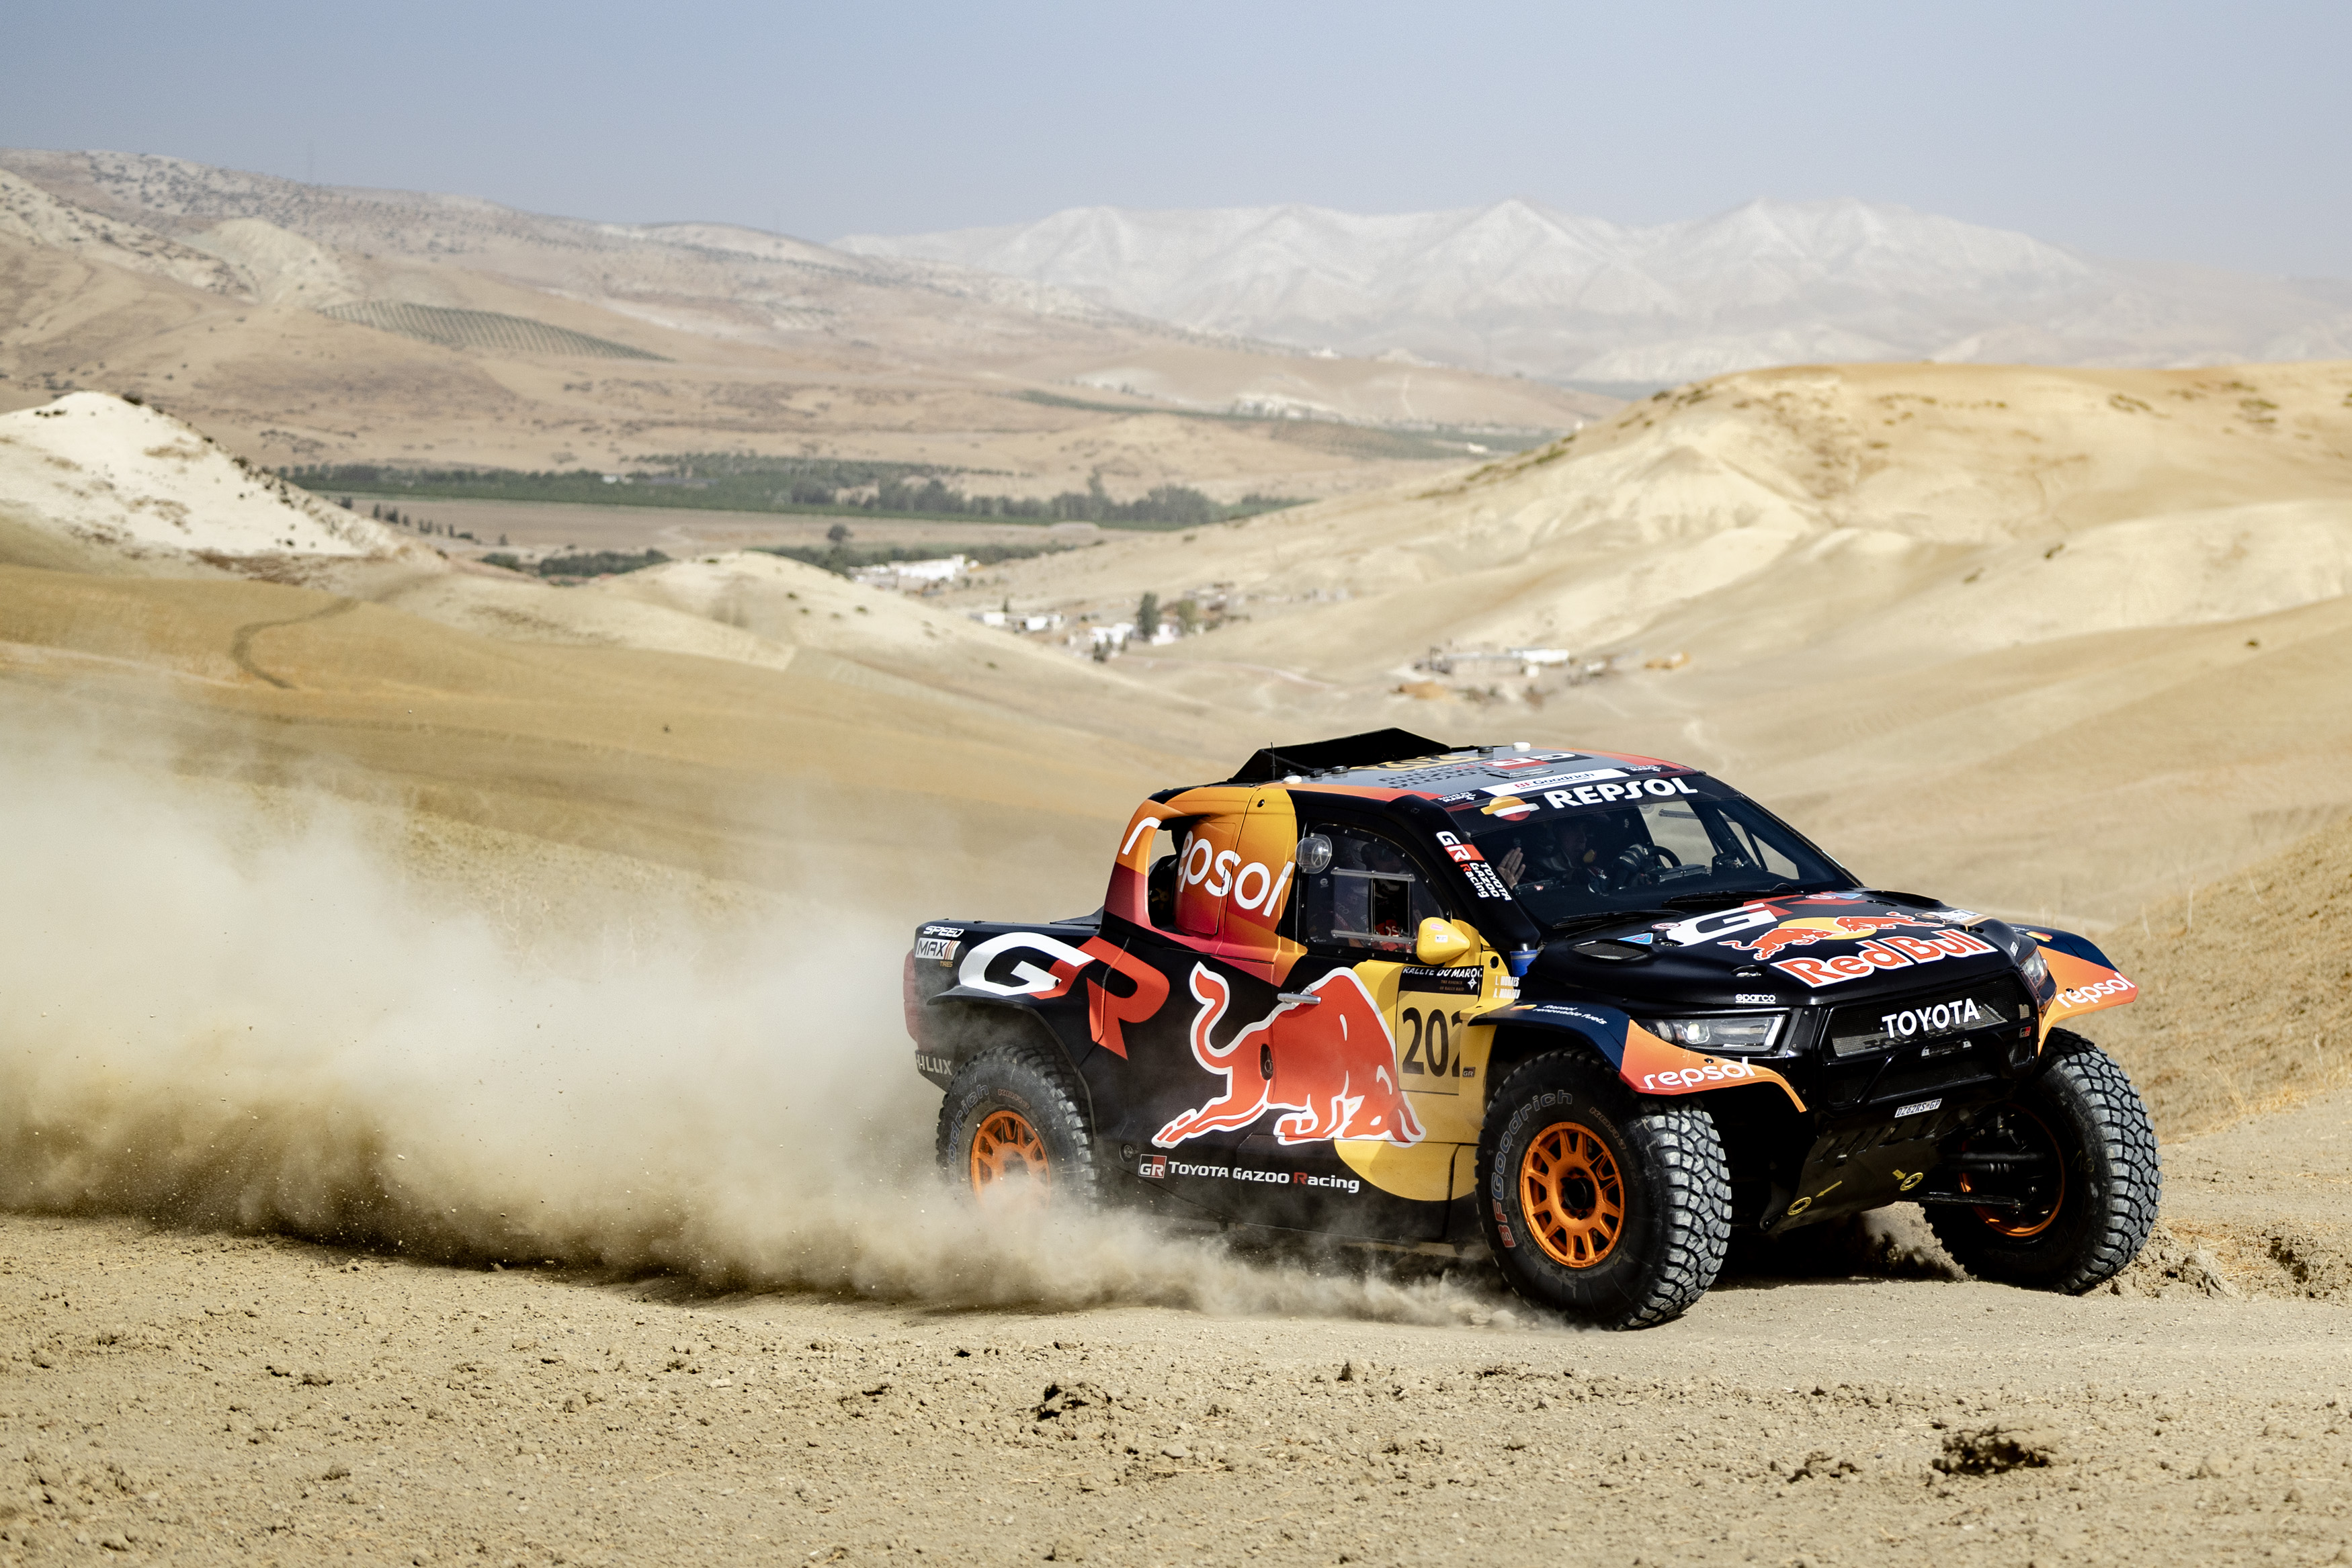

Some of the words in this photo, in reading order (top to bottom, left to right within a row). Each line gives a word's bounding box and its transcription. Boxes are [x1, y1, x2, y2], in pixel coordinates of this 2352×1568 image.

[1513, 771, 1597, 789] BFGoodrich
[1543, 777, 1699, 810] REPSOL
[1435, 830, 1472, 861] GR
[1121, 816, 1296, 918] repsol
[1460, 863, 1490, 898] Racing
[1469, 862, 1501, 898] GAZOO
[1480, 862, 1513, 901] TOYOTA
[917, 940, 948, 957] MAX
[923, 925, 965, 938] SPEED
[1436, 968, 1452, 977] DU
[1450, 967, 1483, 978] MAROC
[1770, 939, 1916, 988] Red
[1876, 928, 1999, 964] Bull
[958, 931, 1171, 1061] GR
[1735, 993, 1776, 1004] sparco
[2056, 971, 2136, 1008] repsol
[1581, 1013, 1607, 1025] fuels
[1881, 998, 1982, 1039] TOYOTA
[1643, 1056, 1756, 1090] repsol
[948, 1084, 990, 1184] oodrich
[1139, 1163, 1165, 1176] GR
[1168, 1161, 1229, 1178] TOYOTA
[1232, 1167, 1290, 1184] GAZOO
[1293, 1172, 1360, 1194] Racing
[1490, 1089, 1573, 1248] BFGoodrich
